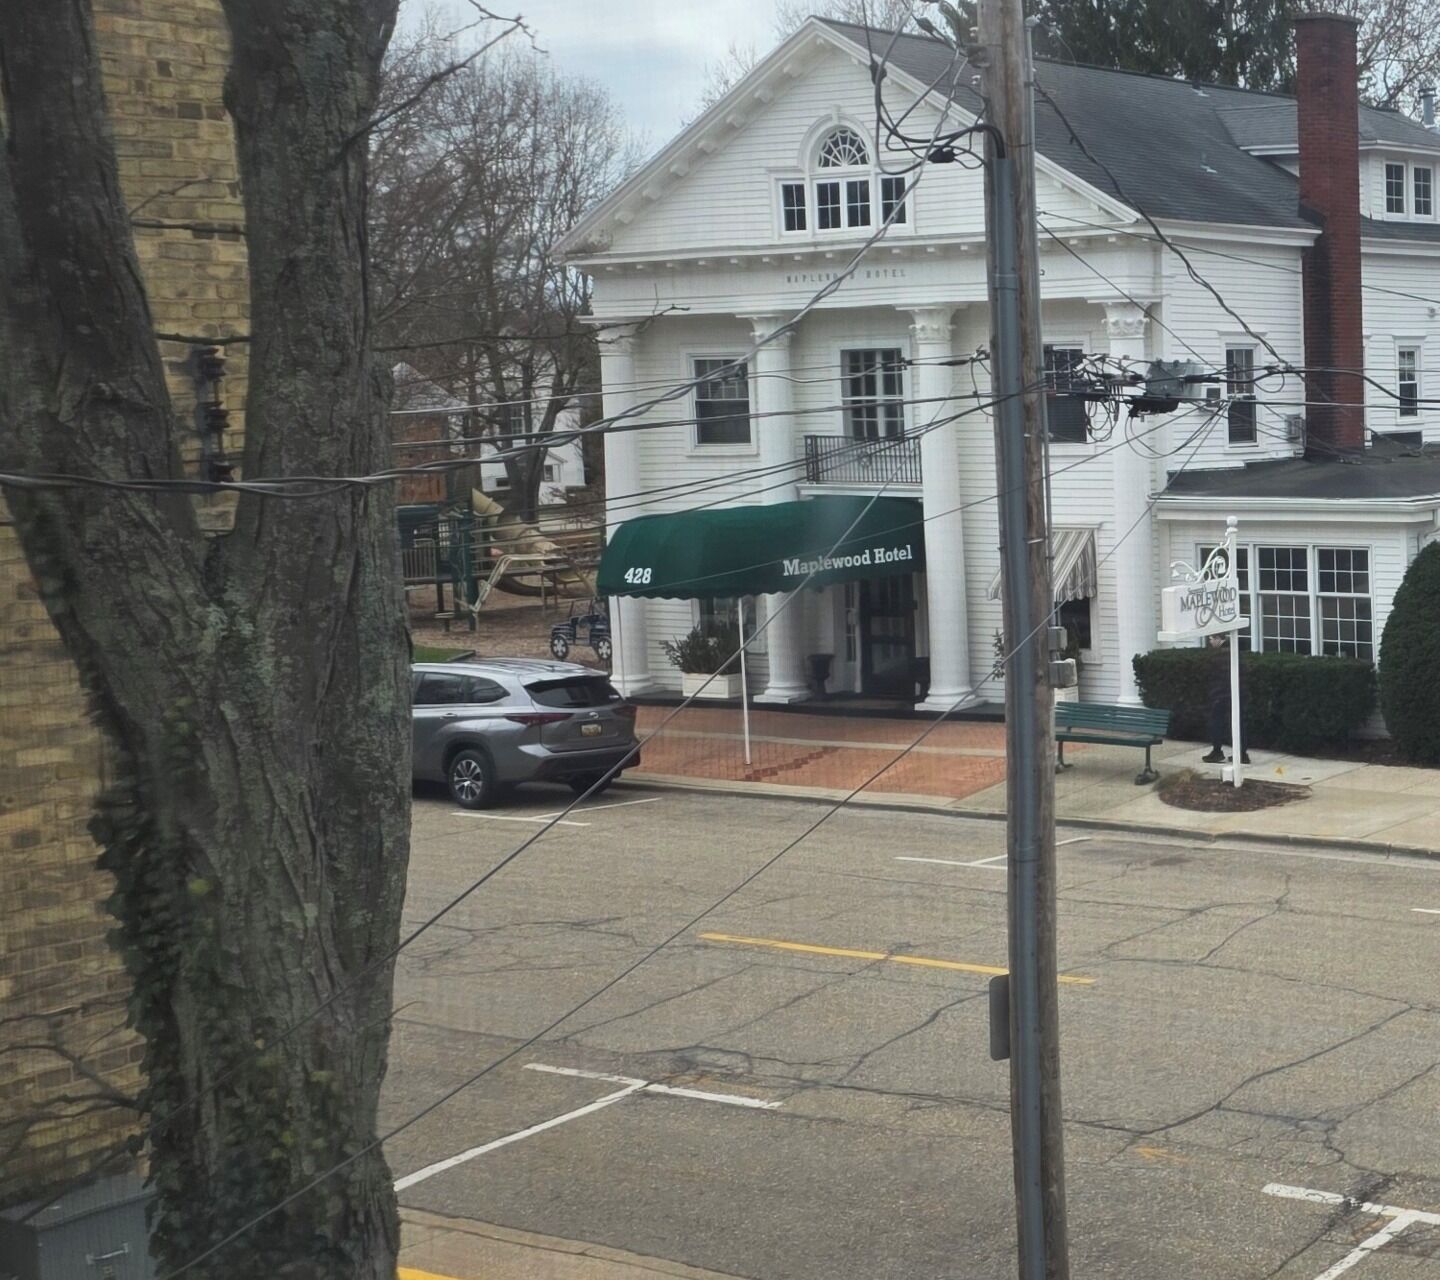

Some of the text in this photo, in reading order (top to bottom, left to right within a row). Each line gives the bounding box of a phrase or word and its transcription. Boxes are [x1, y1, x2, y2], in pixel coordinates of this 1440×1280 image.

[783, 545, 913, 577] Maplewood Hotel
[624, 567, 652, 585] 428
[1180, 586, 1237, 613] MAPLEWOOD
